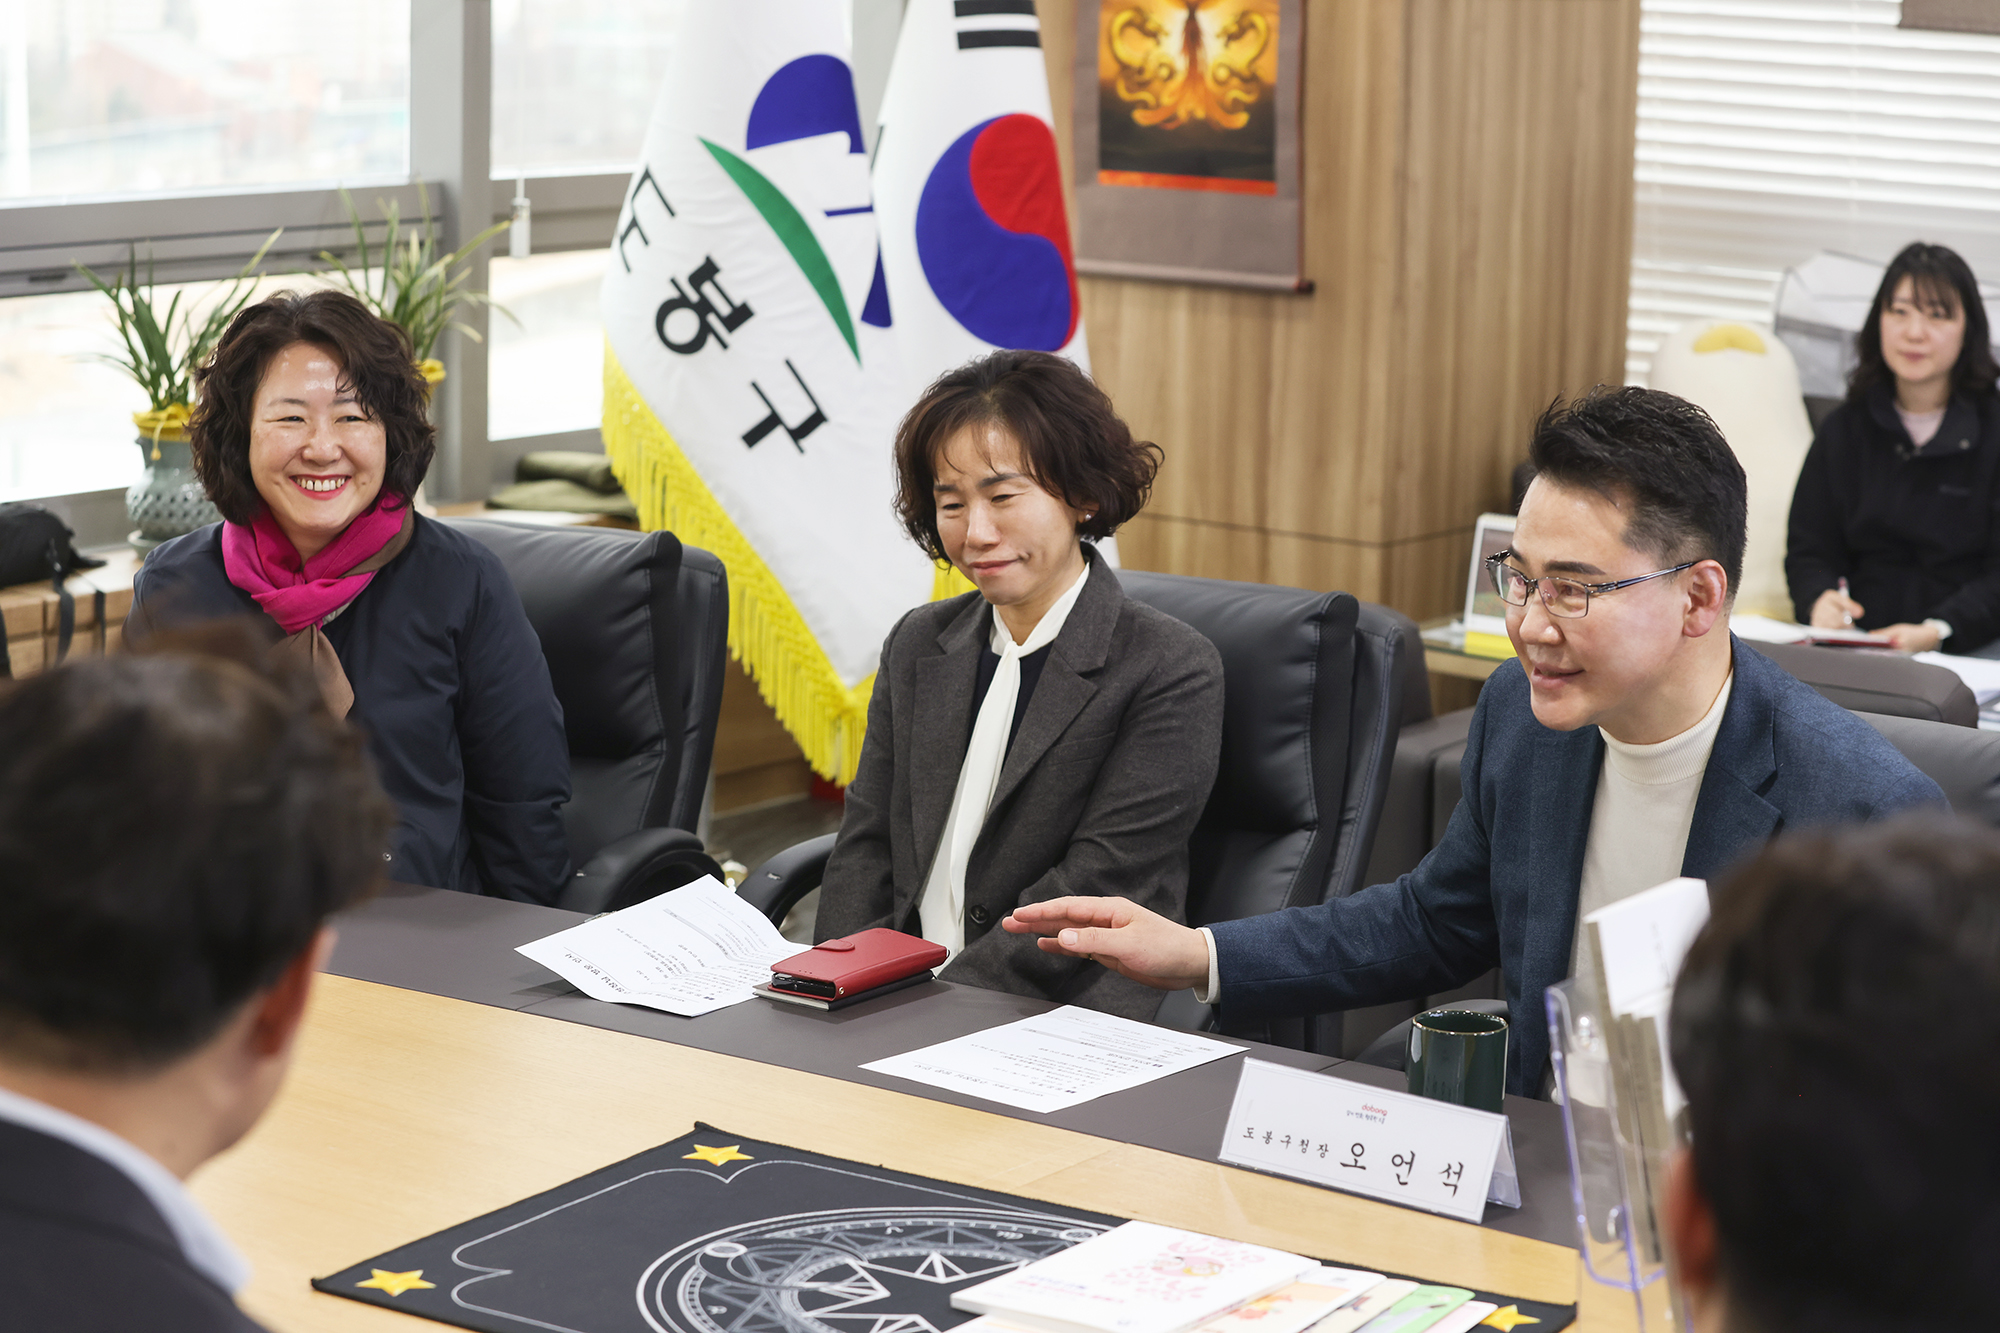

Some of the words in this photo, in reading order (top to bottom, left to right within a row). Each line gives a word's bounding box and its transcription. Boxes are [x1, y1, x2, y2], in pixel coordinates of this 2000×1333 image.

[1361, 1103, 1388, 1117] dobong
[1243, 1127, 1329, 1159] 도봉구청장
[1340, 1142, 1464, 1198] 오언석
